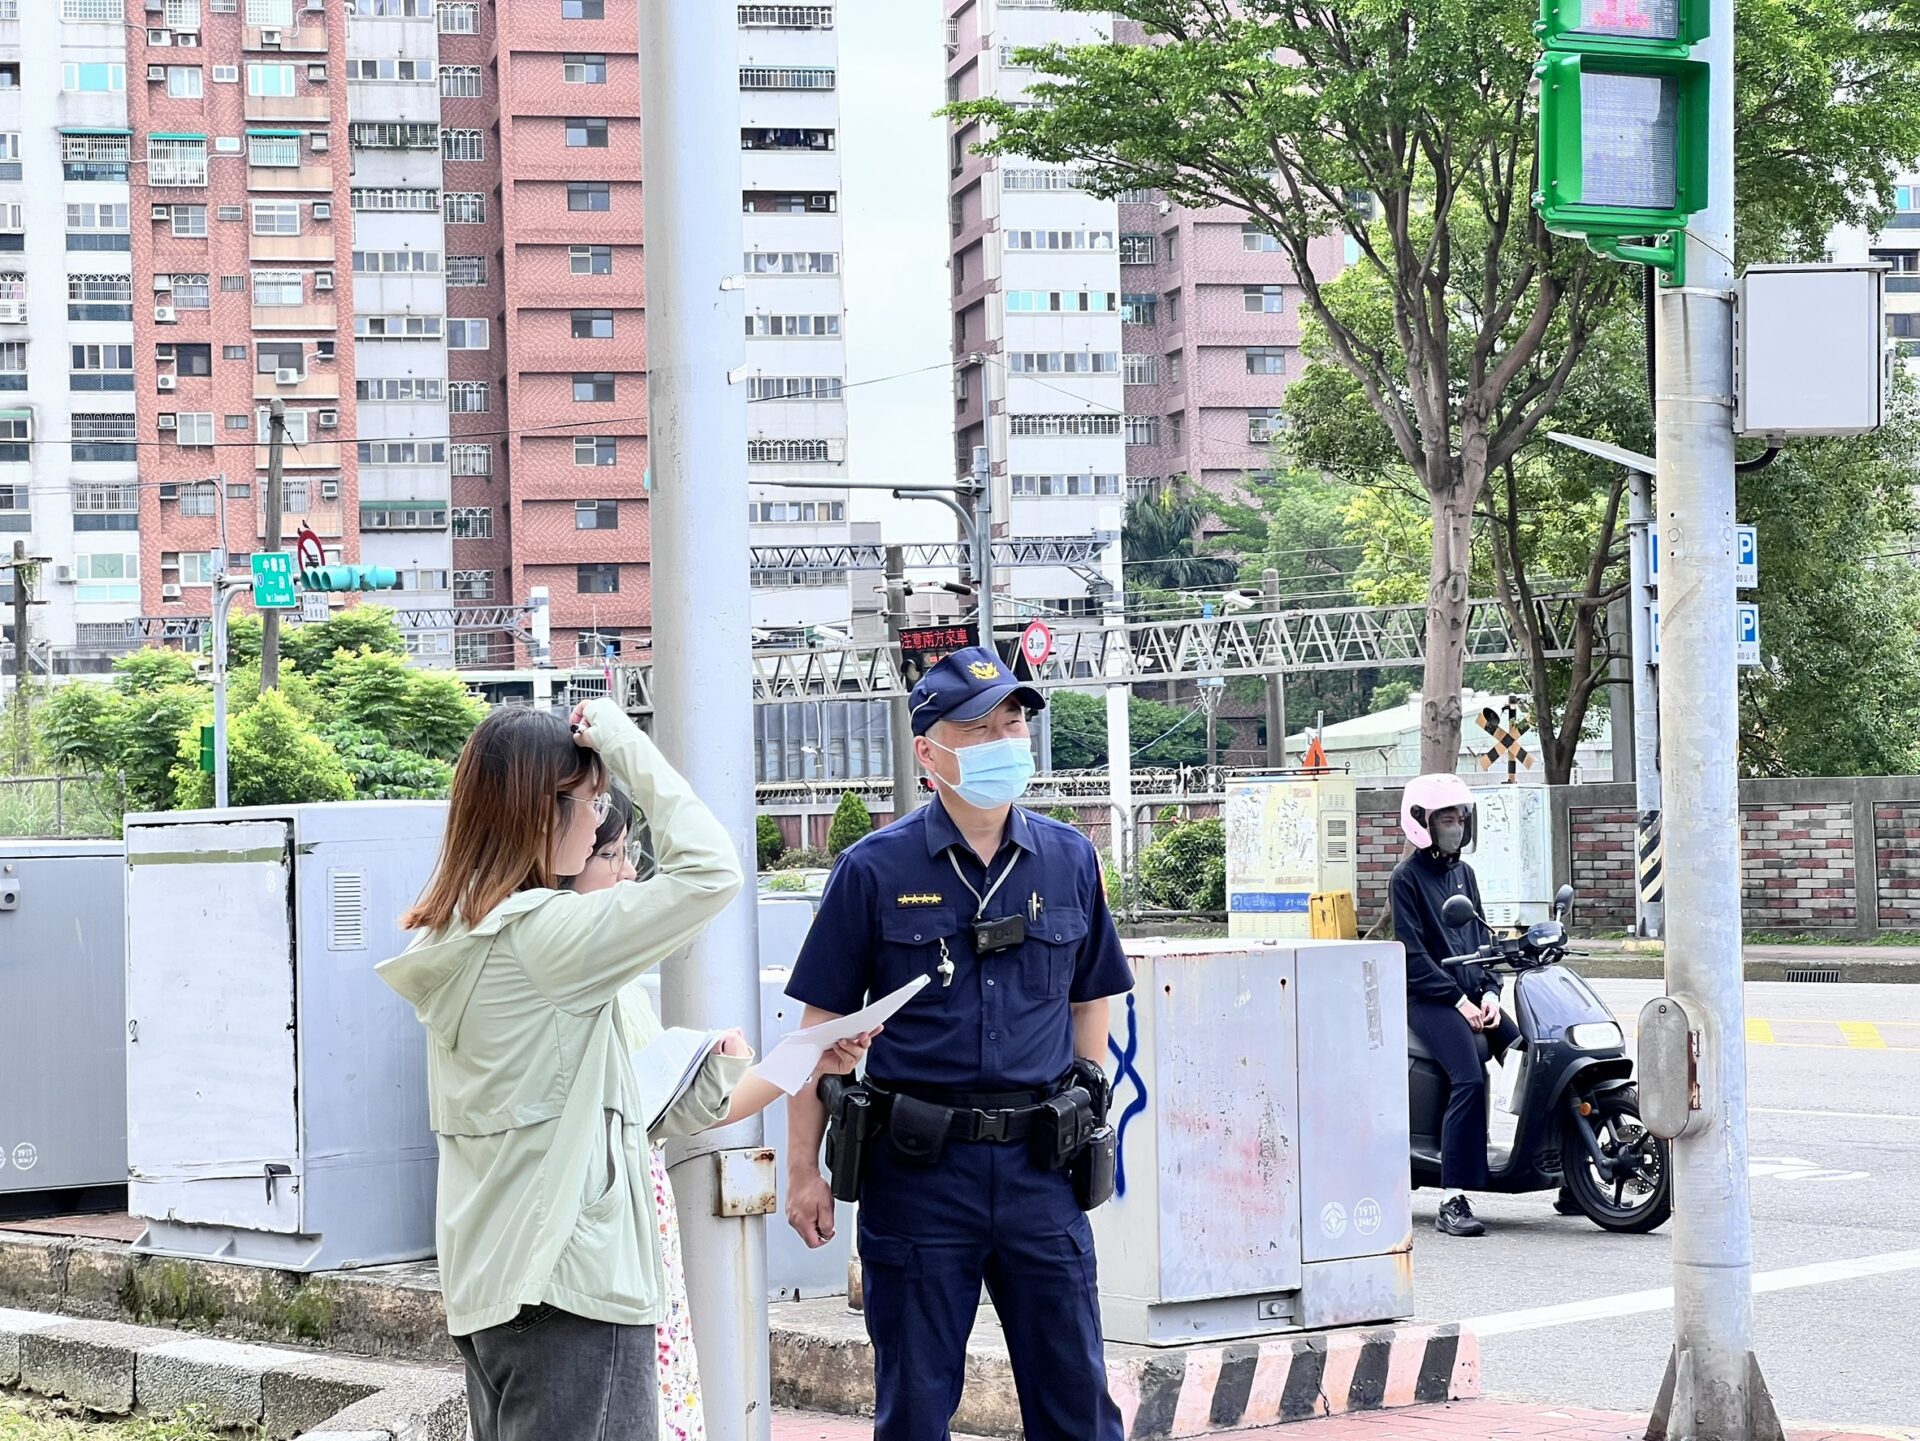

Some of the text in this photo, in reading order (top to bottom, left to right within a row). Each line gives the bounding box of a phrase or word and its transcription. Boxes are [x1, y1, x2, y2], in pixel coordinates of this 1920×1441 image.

[1738, 533, 1752, 563] P
[1740, 610, 1754, 640] P
[900, 628, 968, 649] 注意兩方來車
[1359, 1205, 1376, 1216] 1911
